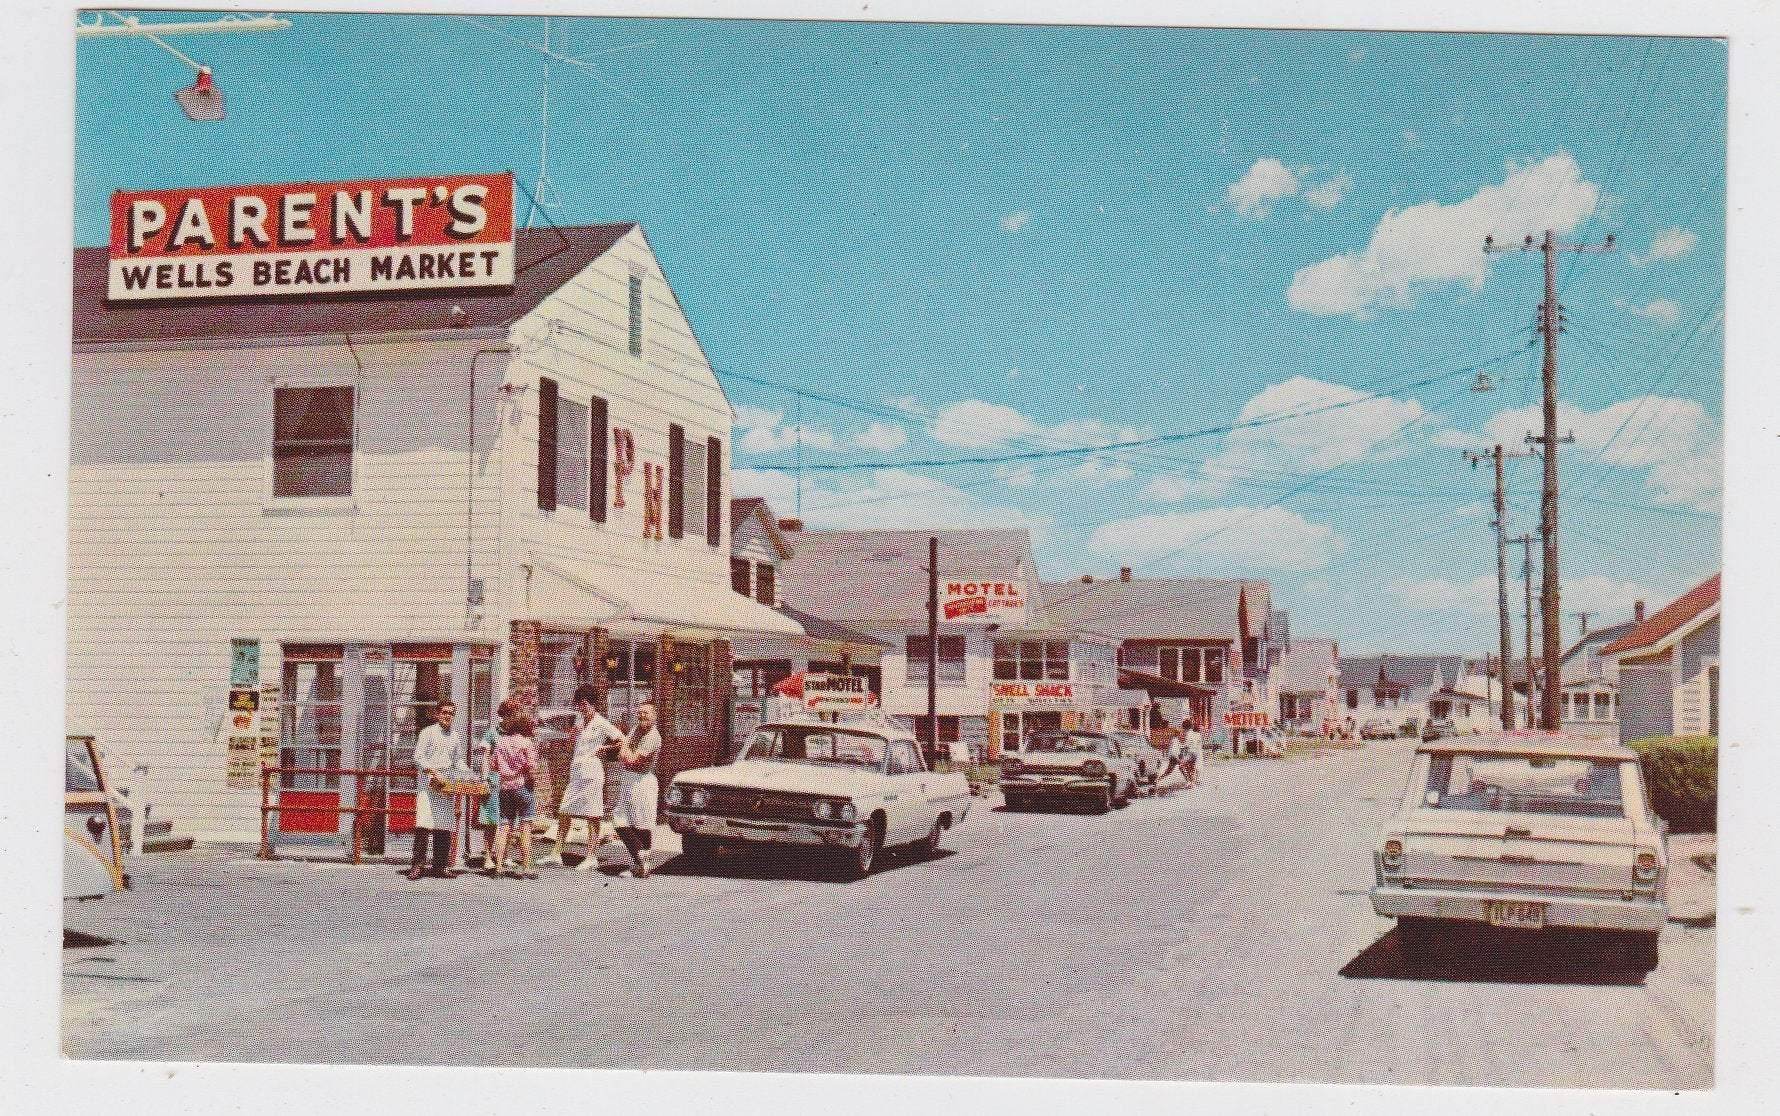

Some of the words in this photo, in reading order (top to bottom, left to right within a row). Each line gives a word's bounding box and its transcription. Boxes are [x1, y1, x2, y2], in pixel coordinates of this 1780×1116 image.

[128, 184, 489, 252] PARENT'S
[121, 262, 234, 291] WELLS
[253, 258, 351, 286] BEACH
[370, 250, 500, 281] MARKET
[947, 583, 1019, 596] MOTEL
[827, 677, 864, 693] MOTEL
